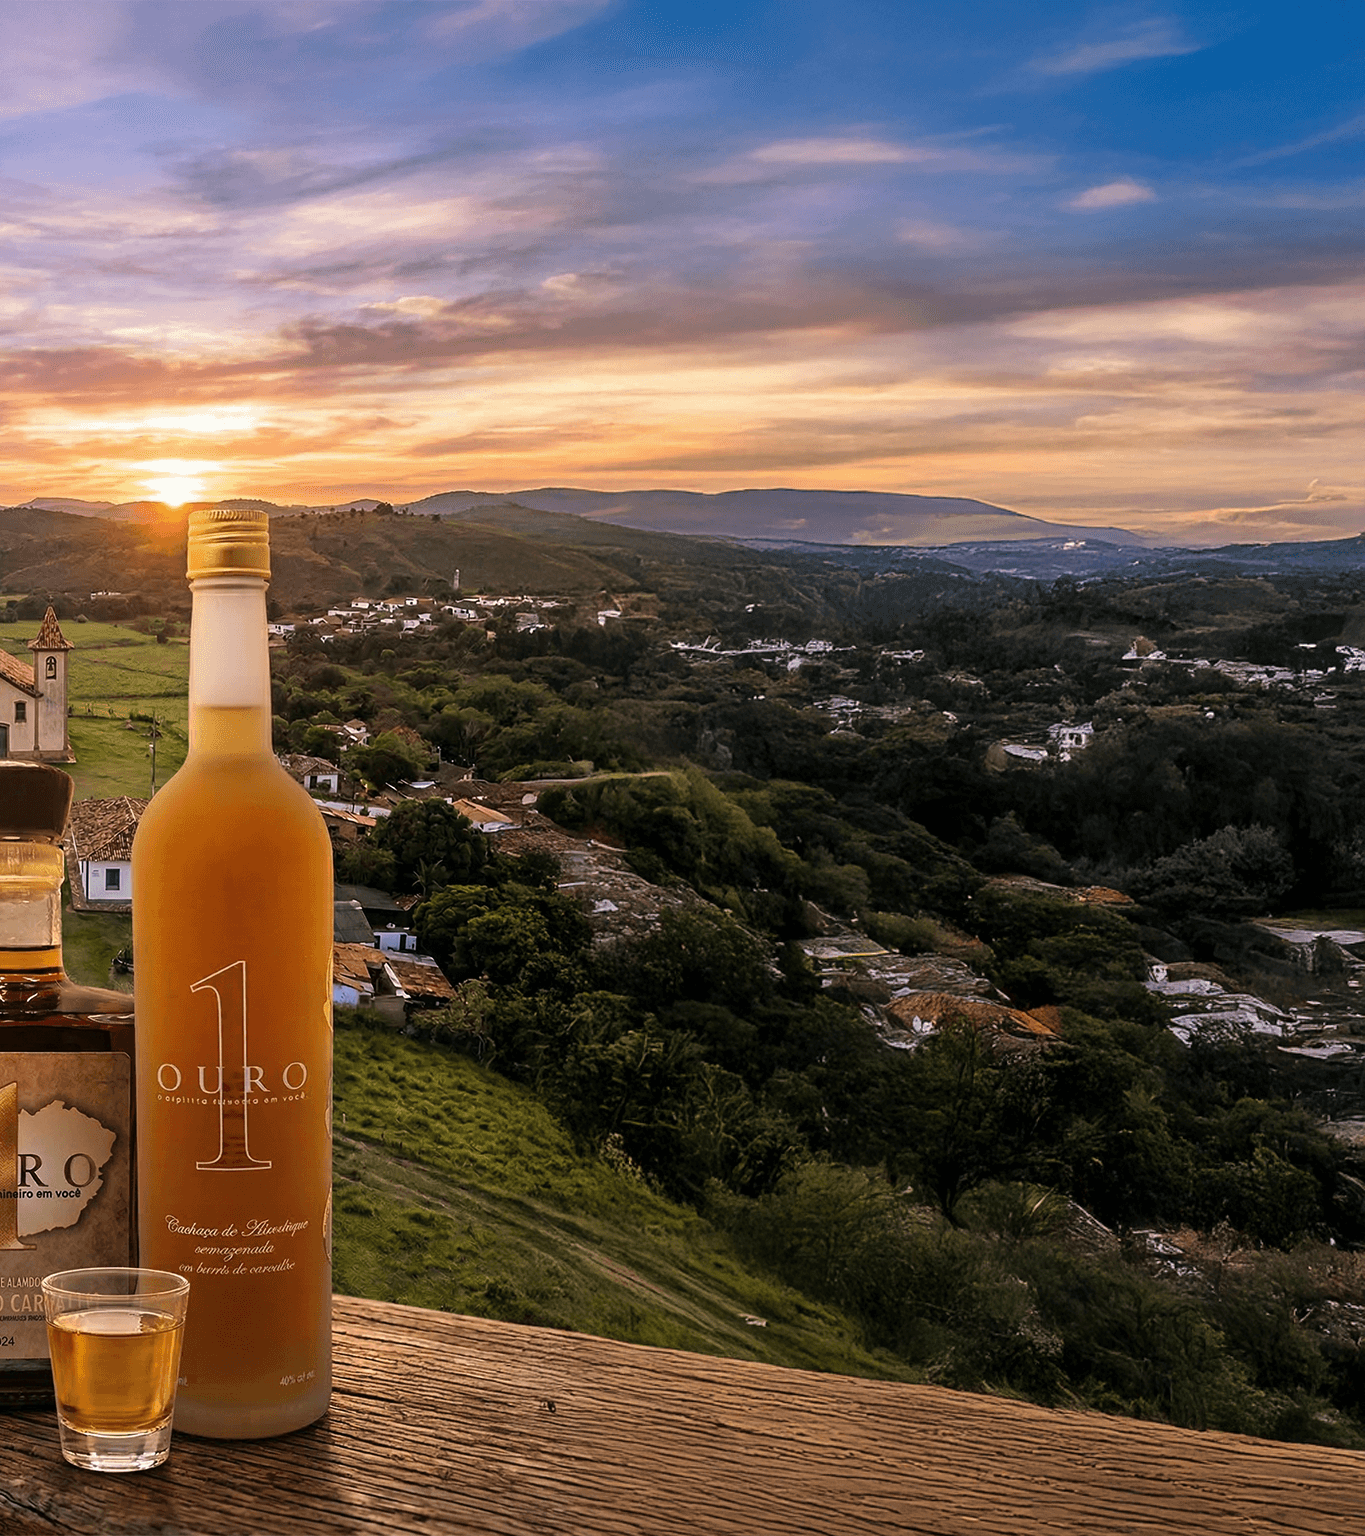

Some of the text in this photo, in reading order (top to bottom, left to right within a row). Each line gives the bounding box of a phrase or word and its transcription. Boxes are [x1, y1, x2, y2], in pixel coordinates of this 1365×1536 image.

[156, 1061, 308, 1095] OURO
[190, 960, 272, 1172] 1
[36, 1189, 54, 1199] em
[55, 1187, 82, 1199] você
[165, 1214, 219, 1239] Cachaça
[221, 1223, 239, 1238] de
[6, 1276, 44, 1289] ALAMDO
